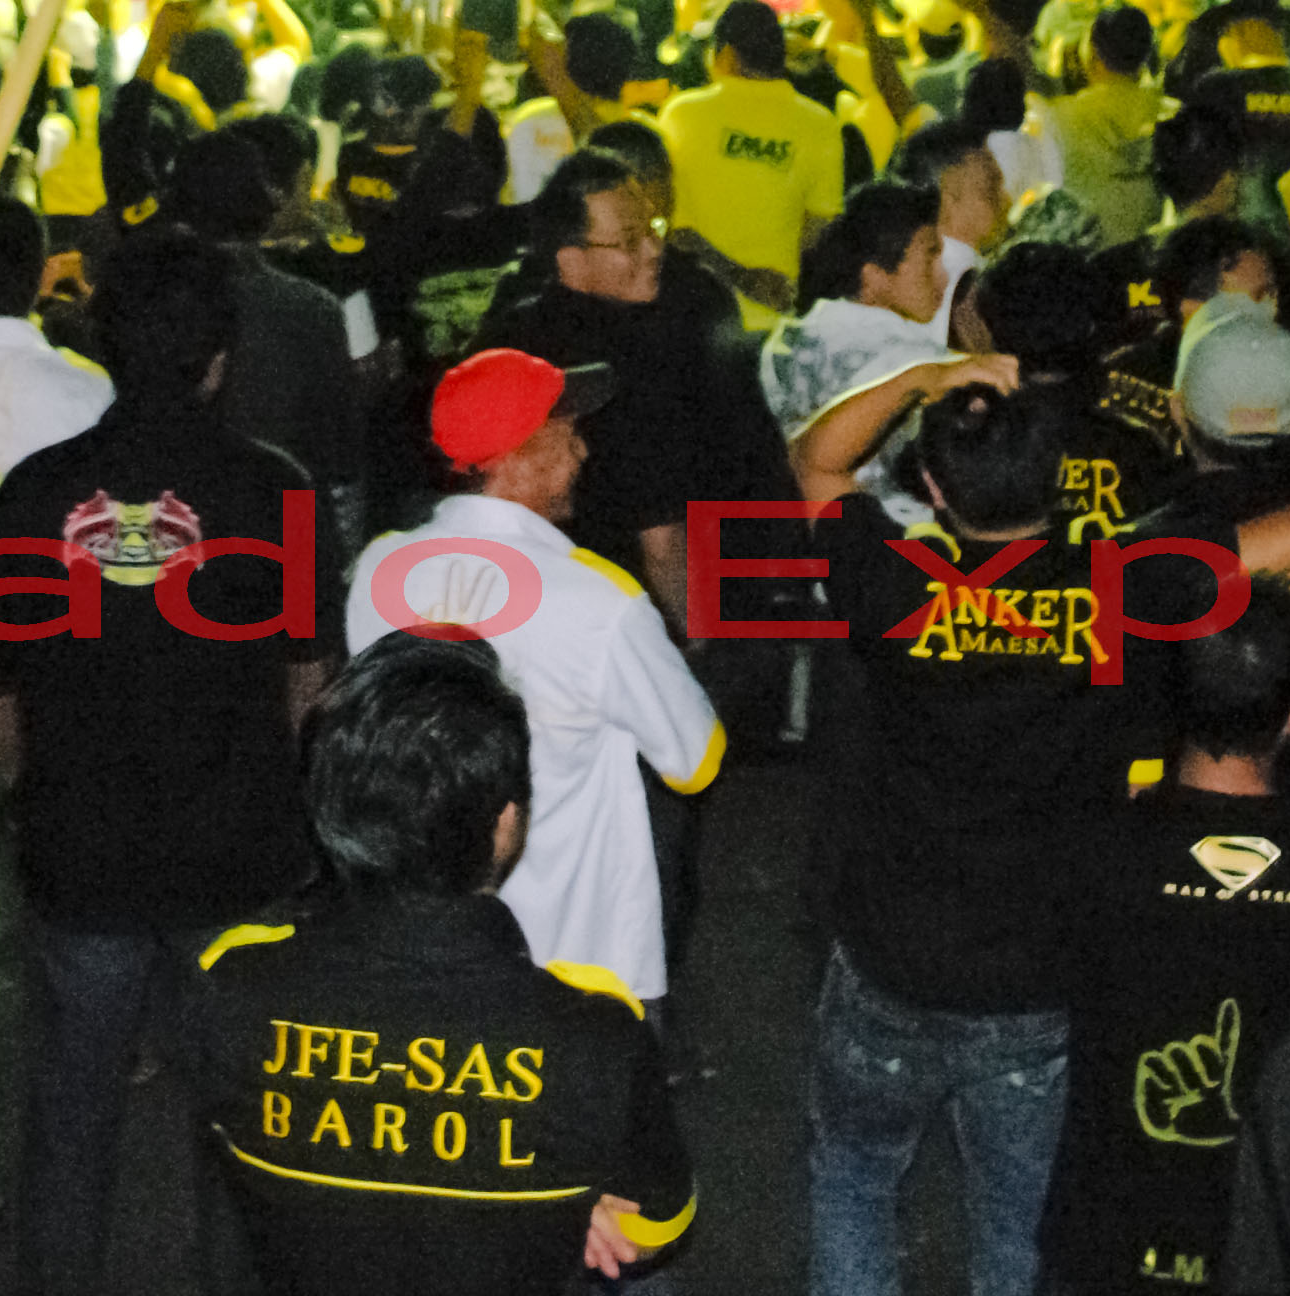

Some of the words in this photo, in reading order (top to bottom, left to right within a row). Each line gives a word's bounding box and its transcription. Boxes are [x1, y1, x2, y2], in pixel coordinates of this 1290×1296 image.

[907, 581, 1109, 666] ANKER
[959, 632, 1063, 657] MAESA
[262, 1019, 545, 1103] JFE-SAS
[262, 1090, 537, 1168] BAROL
